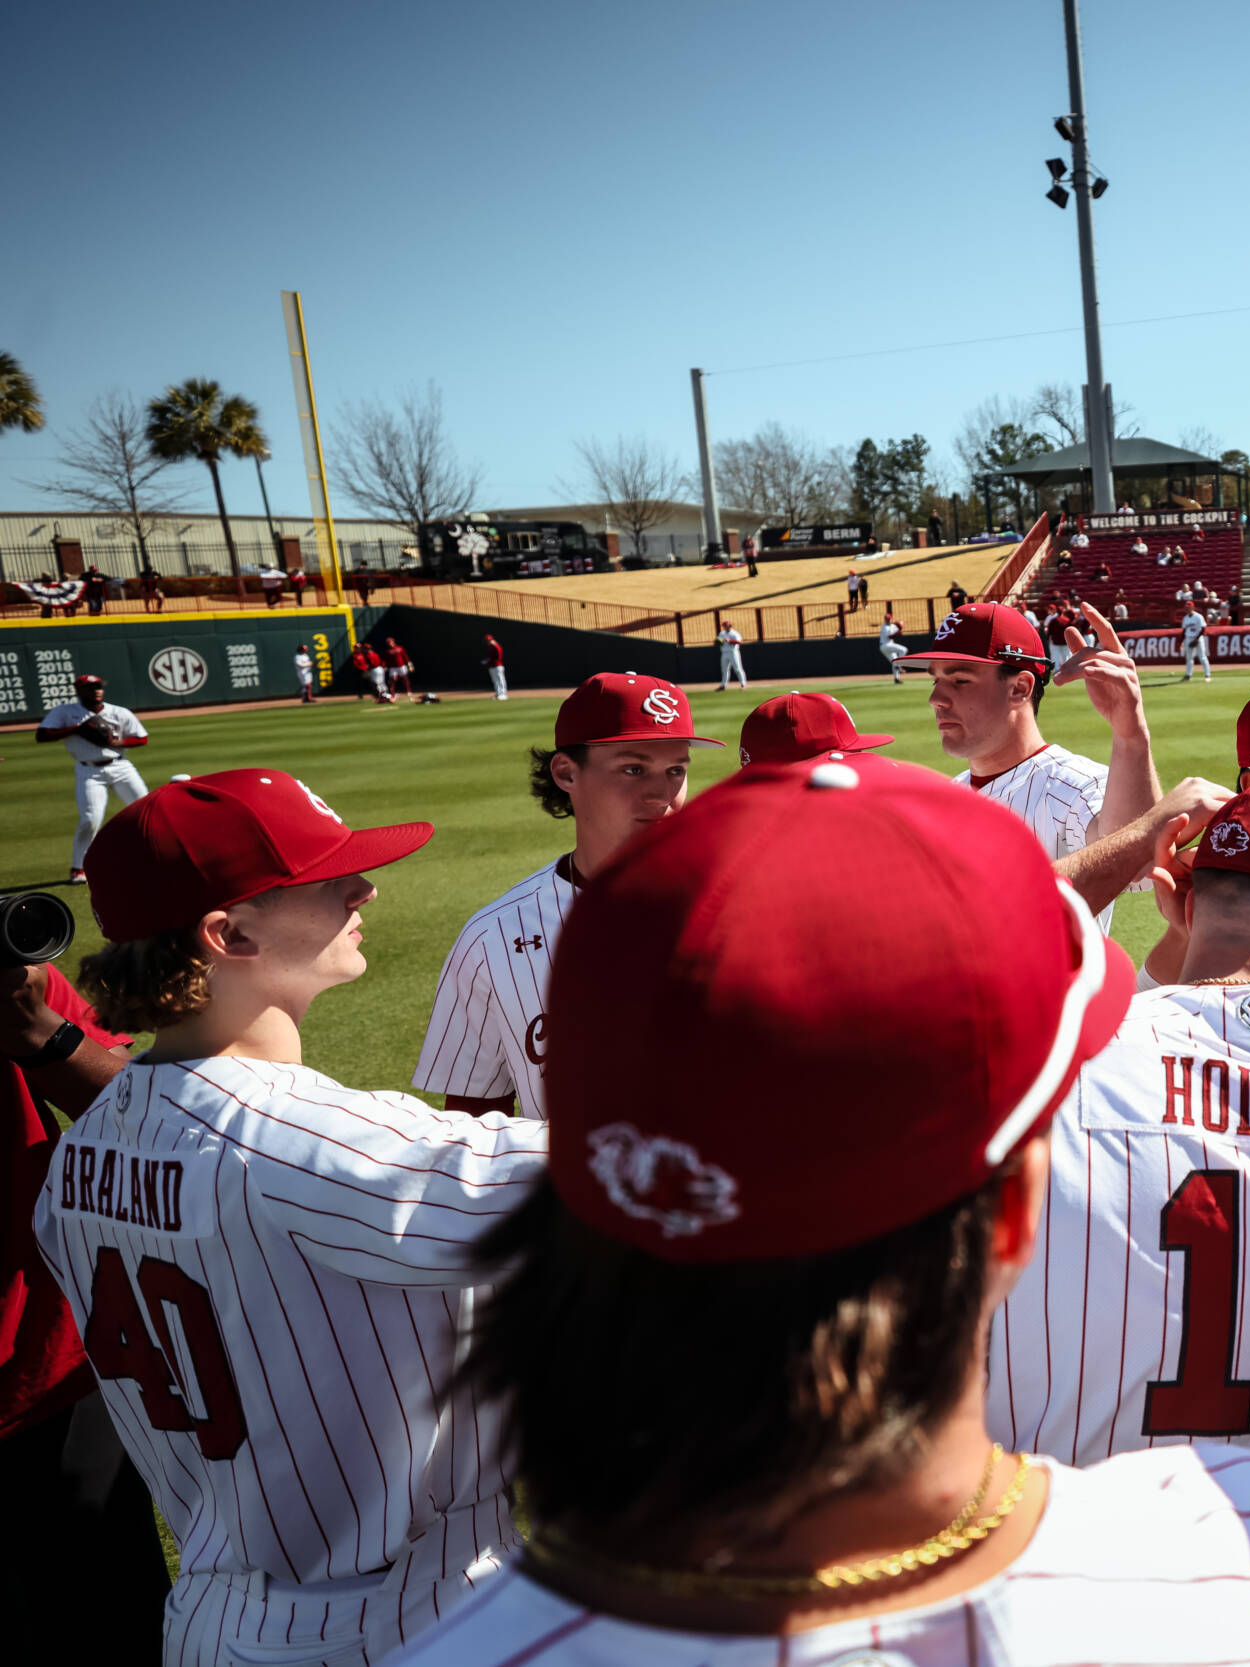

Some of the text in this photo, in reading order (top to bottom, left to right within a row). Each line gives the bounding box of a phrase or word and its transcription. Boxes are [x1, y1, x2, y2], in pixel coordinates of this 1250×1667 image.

[1091, 511, 1228, 529] WELCOME TO THE COCKPIT
[823, 528, 860, 540] BERM
[34, 649, 72, 662] 2016
[312, 633, 333, 687] 325
[0, 664, 19, 676] 11
[36, 661, 74, 673] 2018
[153, 650, 205, 692] SEC
[38, 673, 76, 686] 2021
[61, 1143, 183, 1232] BRALAND
[84, 1246, 248, 1461] 40
